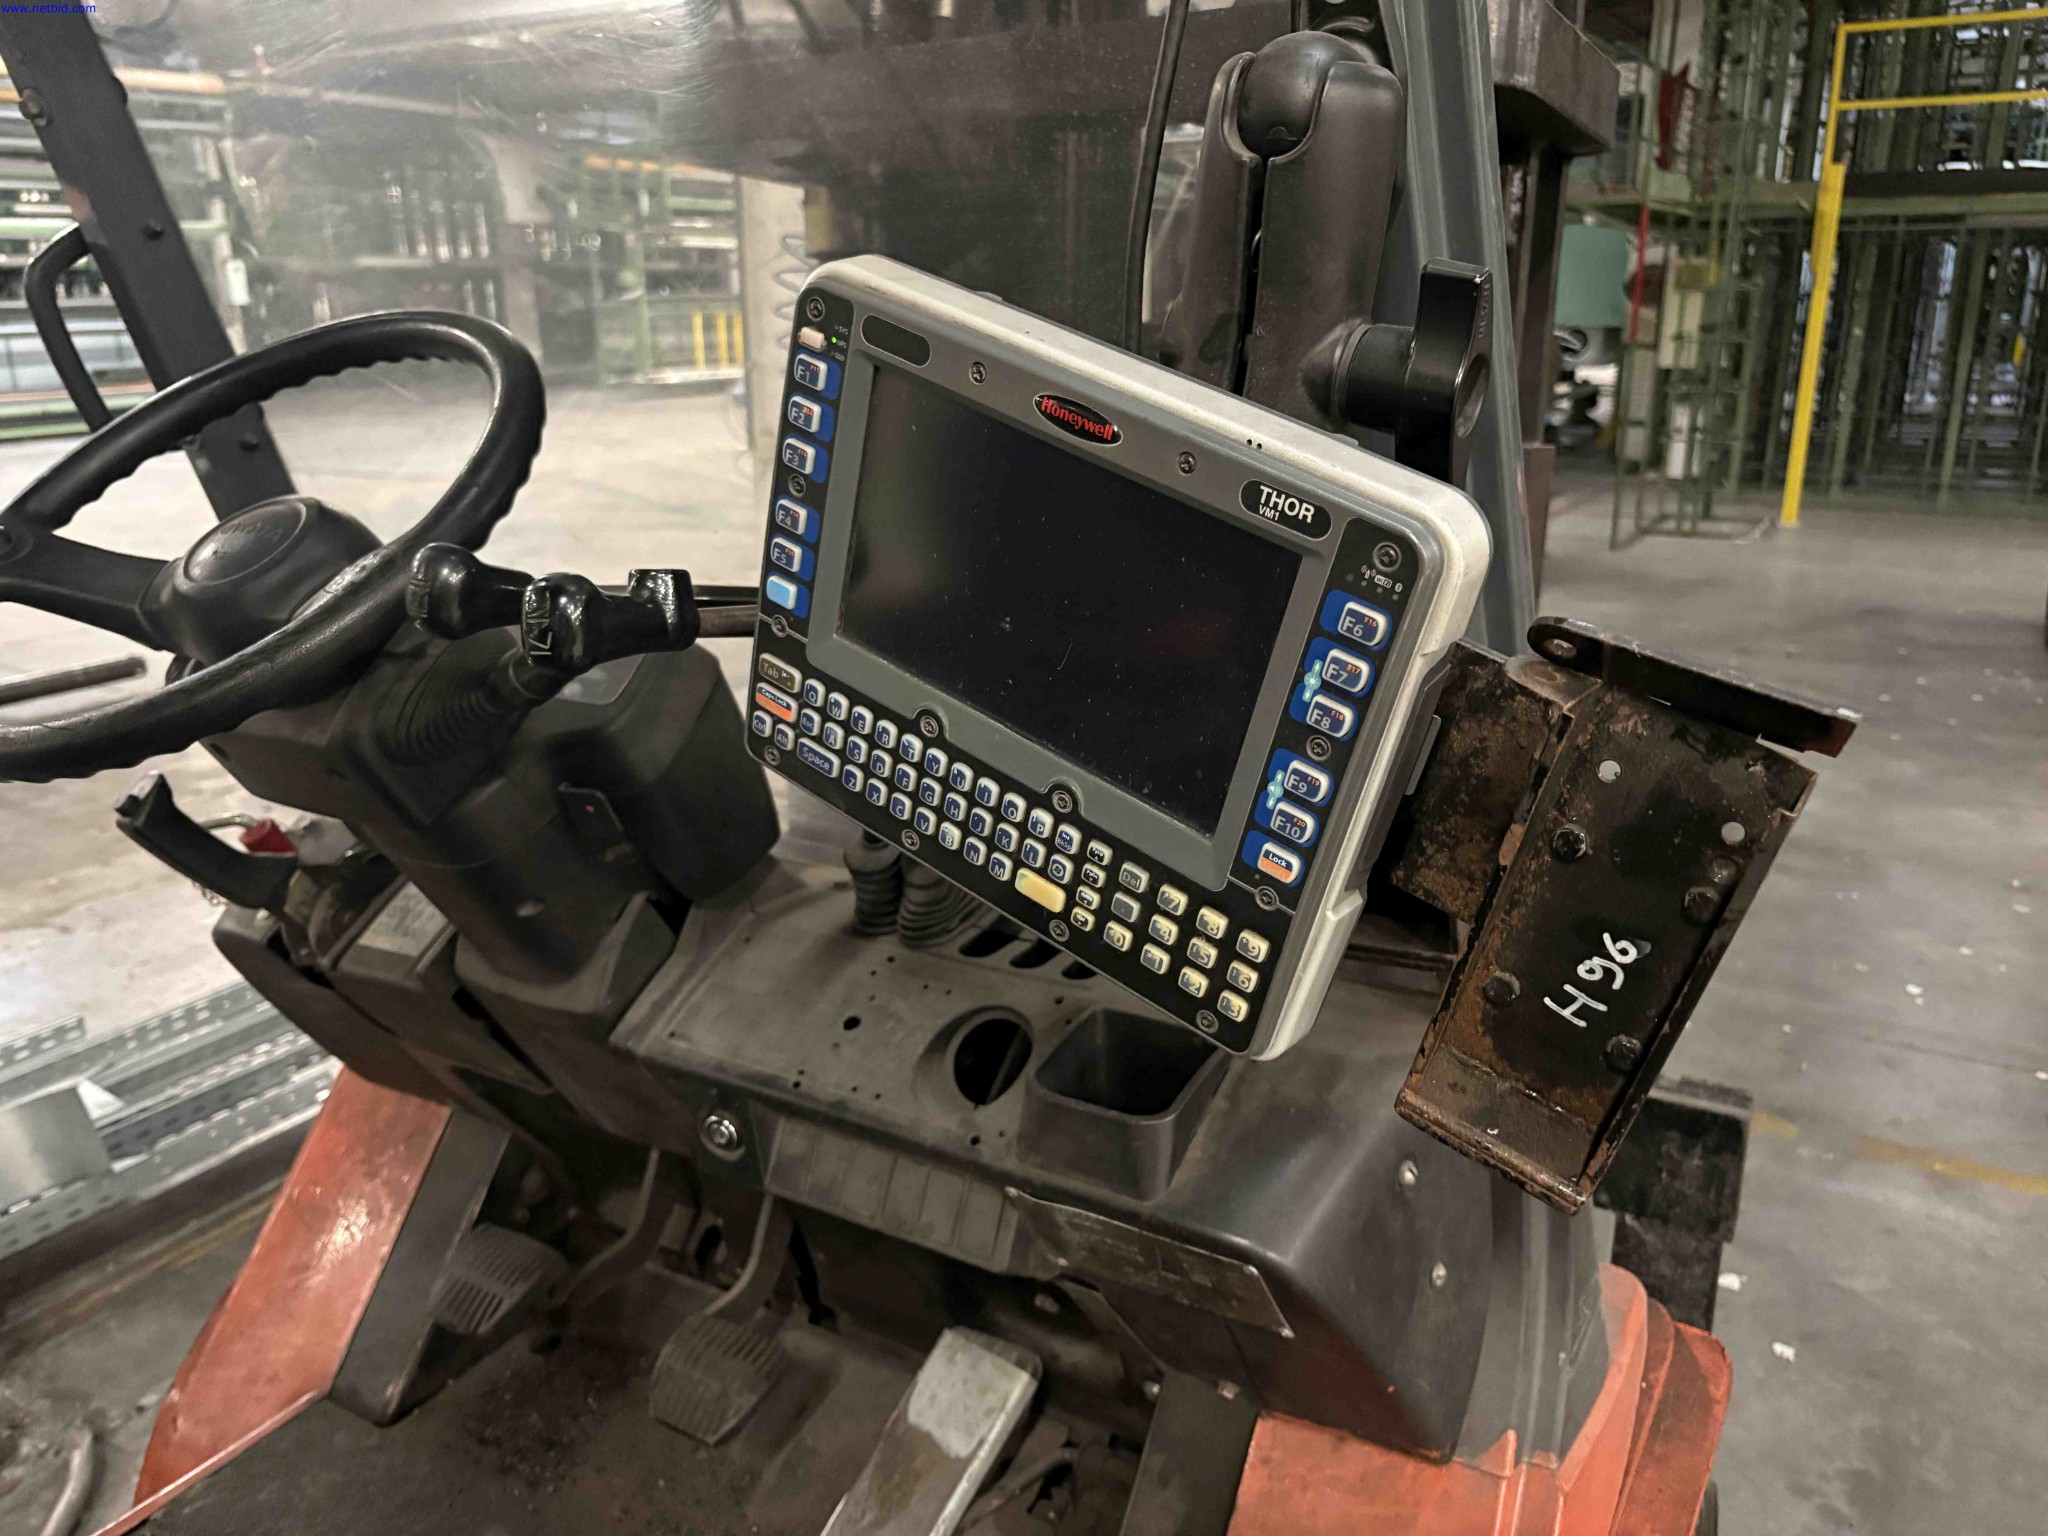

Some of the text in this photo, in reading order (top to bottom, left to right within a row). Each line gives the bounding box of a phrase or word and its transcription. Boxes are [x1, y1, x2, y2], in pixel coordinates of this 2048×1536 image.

[797, 364, 810, 382] F1
[791, 407, 804, 425] F2
[1041, 396, 1114, 440] Honeywell
[785, 449, 799, 466] F3
[1259, 485, 1315, 524] THOR
[778, 510, 792, 527] F4
[1259, 505, 1279, 521] VM1
[773, 549, 787, 564] F5
[1342, 616, 1363, 637] F6
[1364, 617, 1377, 627] F16
[763, 663, 779, 679] Tab
[1327, 663, 1348, 683] F7
[762, 689, 788, 707] Caps Lock
[808, 691, 816, 704] Q
[832, 705, 841, 717] W
[754, 719, 766, 731] Ctrl
[802, 717, 813, 729] Esc
[858, 720, 865, 731] E
[1311, 709, 1331, 729] F8
[828, 735, 836, 746] A
[882, 734, 889, 744] R
[803, 747, 830, 771] Space
[854, 749, 860, 760] S
[908, 748, 915, 760] T
[876, 763, 884, 774] D
[932, 762, 939, 774] Y
[849, 778, 856, 788] Z
[902, 778, 909, 789] F
[957, 778, 965, 789] U
[1288, 774, 1308, 793] F9
[1307, 775, 1320, 786] F19
[872, 791, 879, 803] X
[925, 791, 932, 803] G
[896, 805, 904, 817] C
[950, 806, 958, 817] H
[920, 819, 928, 830] V
[976, 822, 982, 832] J
[1274, 815, 1300, 839] F10
[1293, 817, 1306, 828] F20
[1036, 824, 1044, 835] P
[945, 835, 953, 847] B
[1001, 835, 1009, 848] K
[1057, 838, 1072, 851] BkSp
[969, 850, 978, 863] N
[1029, 852, 1035, 864] L
[1269, 853, 1287, 868] Lock
[994, 865, 1004, 878] M
[1123, 872, 1140, 888] Del
[1168, 898, 1180, 909] 7
[1160, 927, 1171, 941] 4
[1207, 921, 1219, 936] 8
[1199, 950, 1210, 964] 5
[1247, 944, 1260, 957] 9
[1238, 974, 1250, 988] 6
[1543, 932, 1638, 1028] H96
[1189, 980, 1201, 994] 2
[1228, 1004, 1240, 1017] 3
